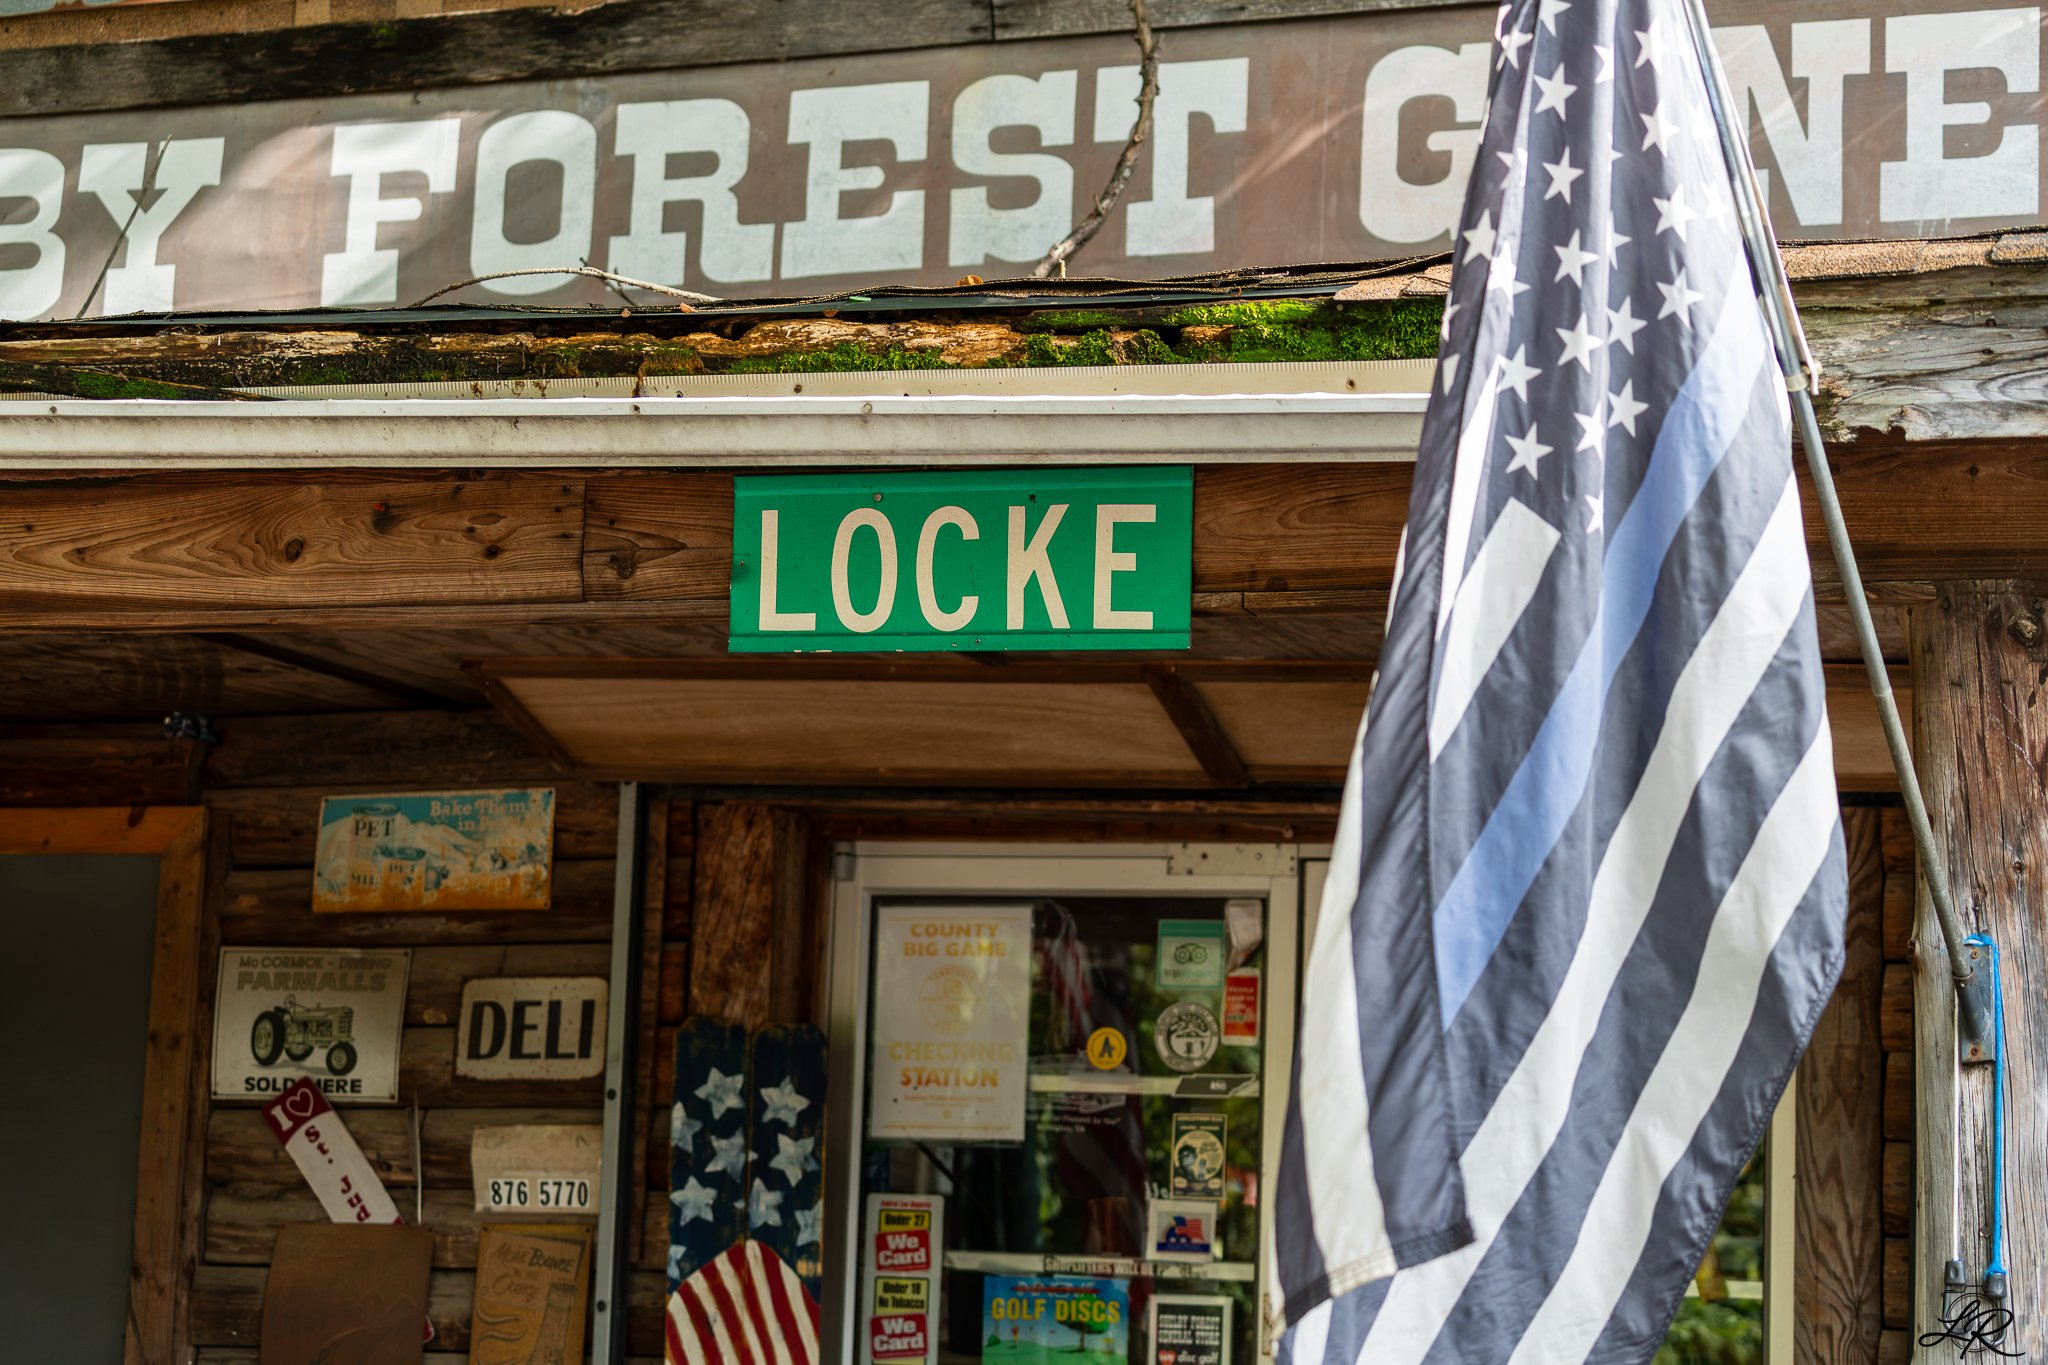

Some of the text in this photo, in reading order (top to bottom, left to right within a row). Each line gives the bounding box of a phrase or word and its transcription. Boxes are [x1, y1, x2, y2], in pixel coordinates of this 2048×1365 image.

[321, 57, 1249, 306] FOREST
[1360, 7, 2041, 244] GNE
[758, 503, 1157, 633] LOCKE
[353, 818, 396, 838] PET
[909, 923, 1001, 939] COUNTY
[902, 941, 1007, 957] BIG GAME
[236, 970, 389, 992] FARMALLS
[466, 999, 597, 1061] DELI
[887, 1041, 1014, 1062] CHECKING
[900, 1066, 999, 1088] STATION
[490, 1180, 590, 1207] 876 5770
[884, 1213, 926, 1227] Under 27
[886, 1234, 920, 1250] We
[878, 1247, 928, 1267] Card
[882, 1281, 910, 1295] Under
[891, 1296, 925, 1310] Tobacco
[990, 1297, 1121, 1323] GOLF DISCS
[880, 1317, 917, 1334] We
[872, 1331, 926, 1353] Card
[1177, 1349, 1197, 1362] disc
[1198, 1351, 1220, 1365] golf
